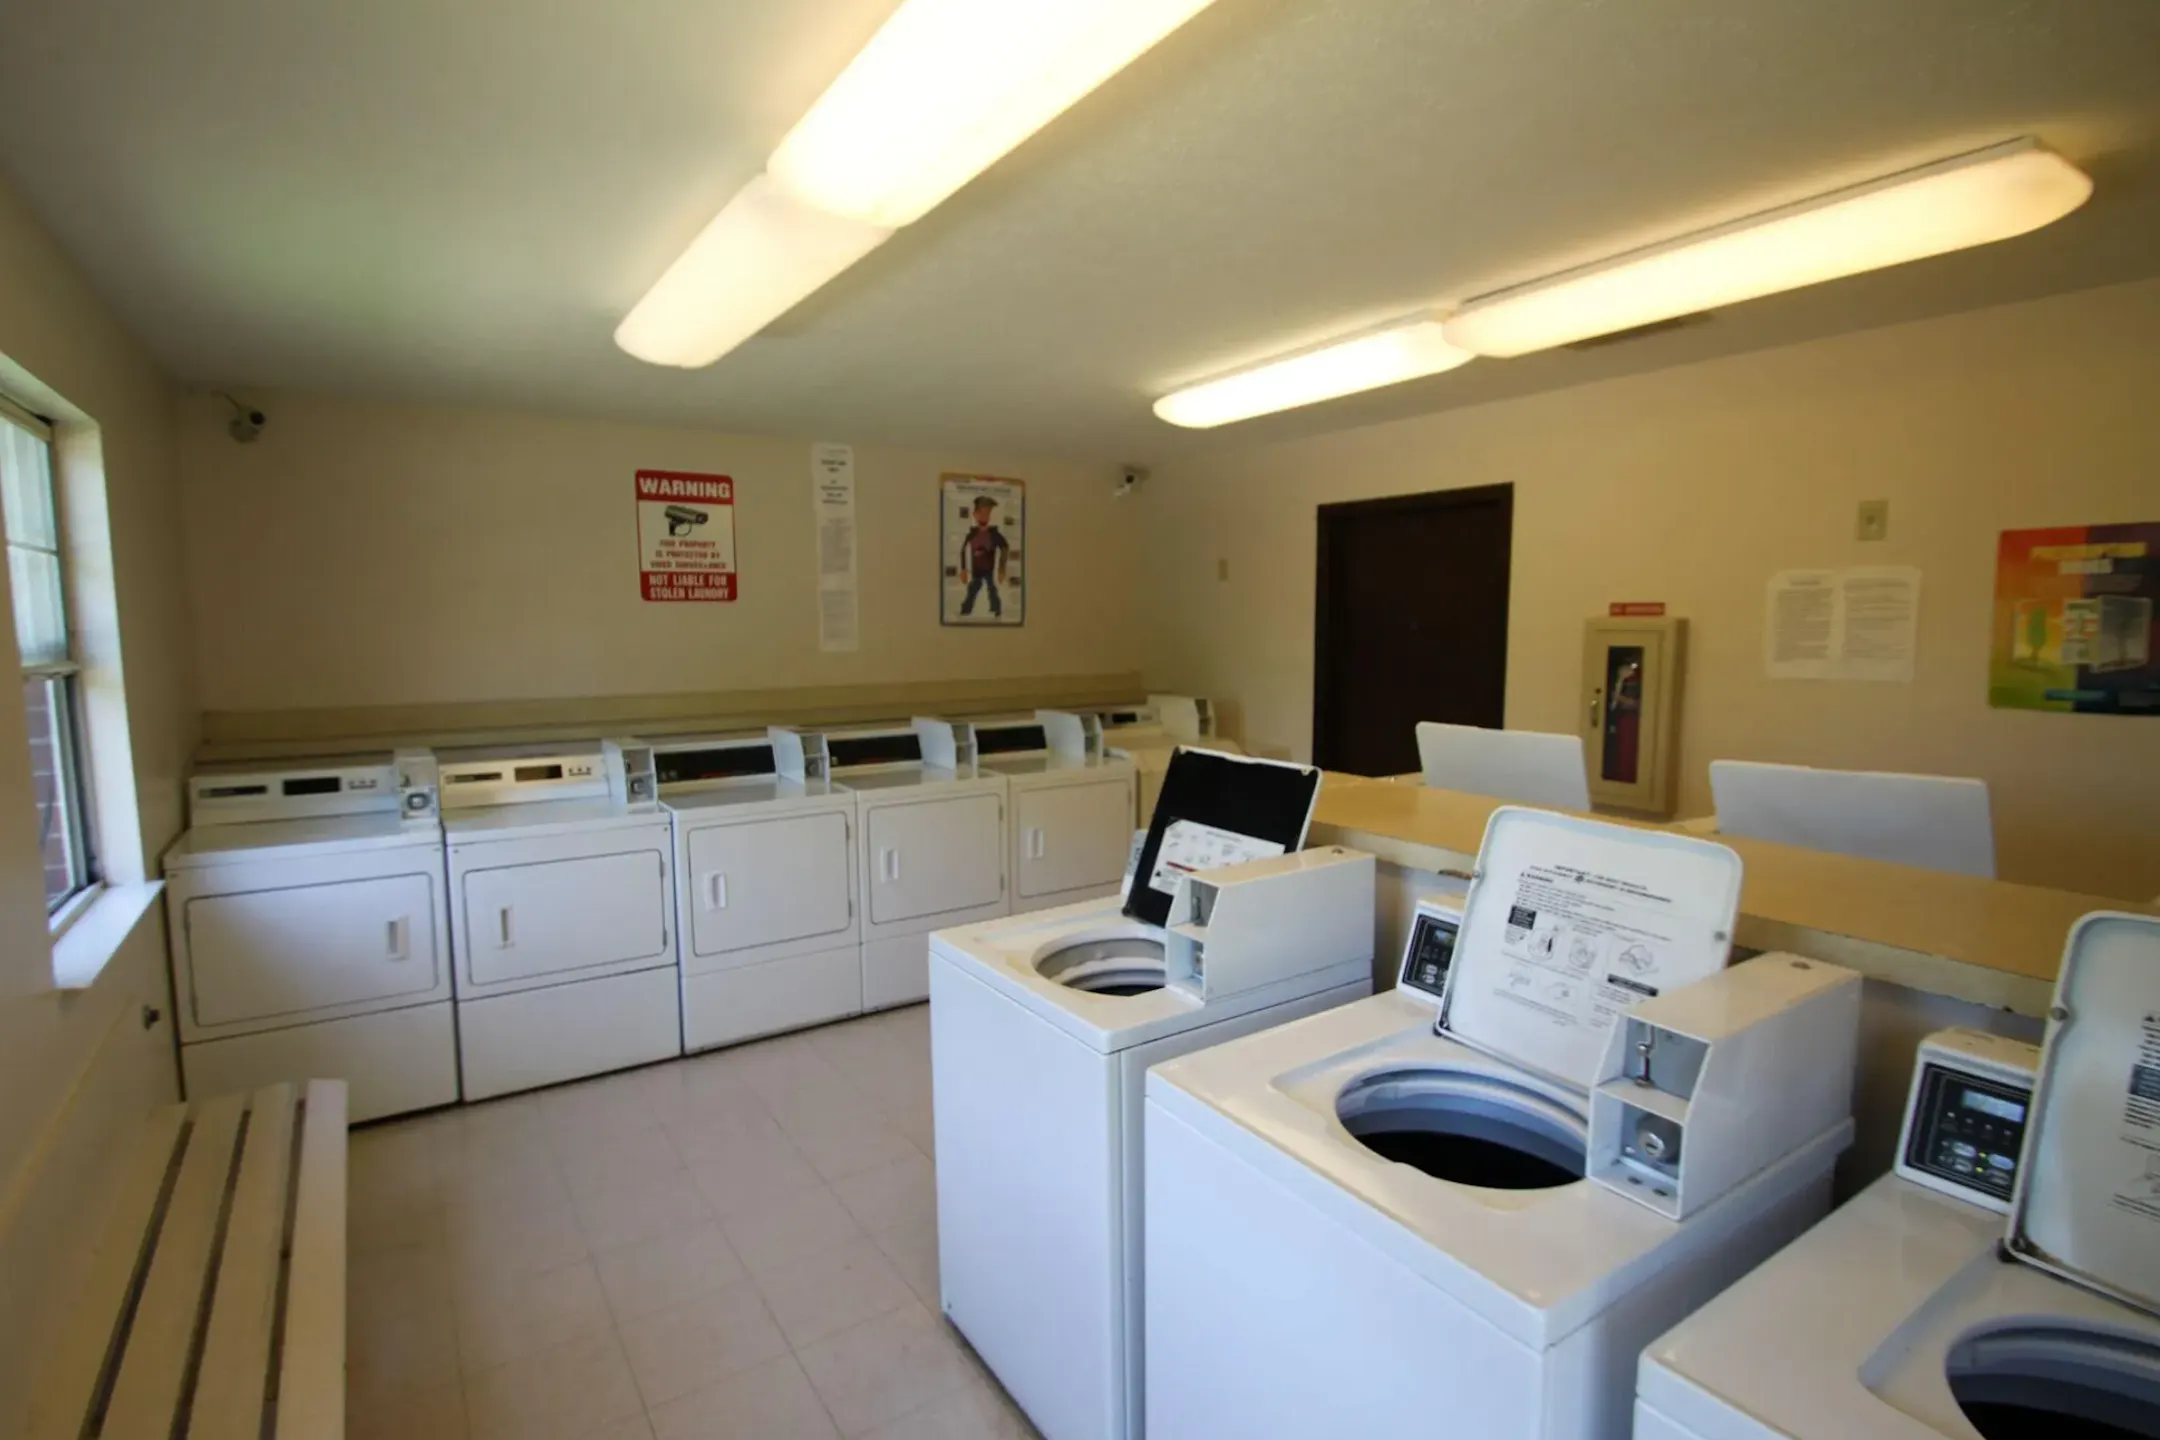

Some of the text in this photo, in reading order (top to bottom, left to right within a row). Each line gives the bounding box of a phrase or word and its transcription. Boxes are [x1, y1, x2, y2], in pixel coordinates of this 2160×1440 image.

[640, 478, 730, 498] WARNING
[649, 573, 728, 587] NOT LIABLE FOR
[650, 587, 728, 600] STOLEN LAUNDRY
